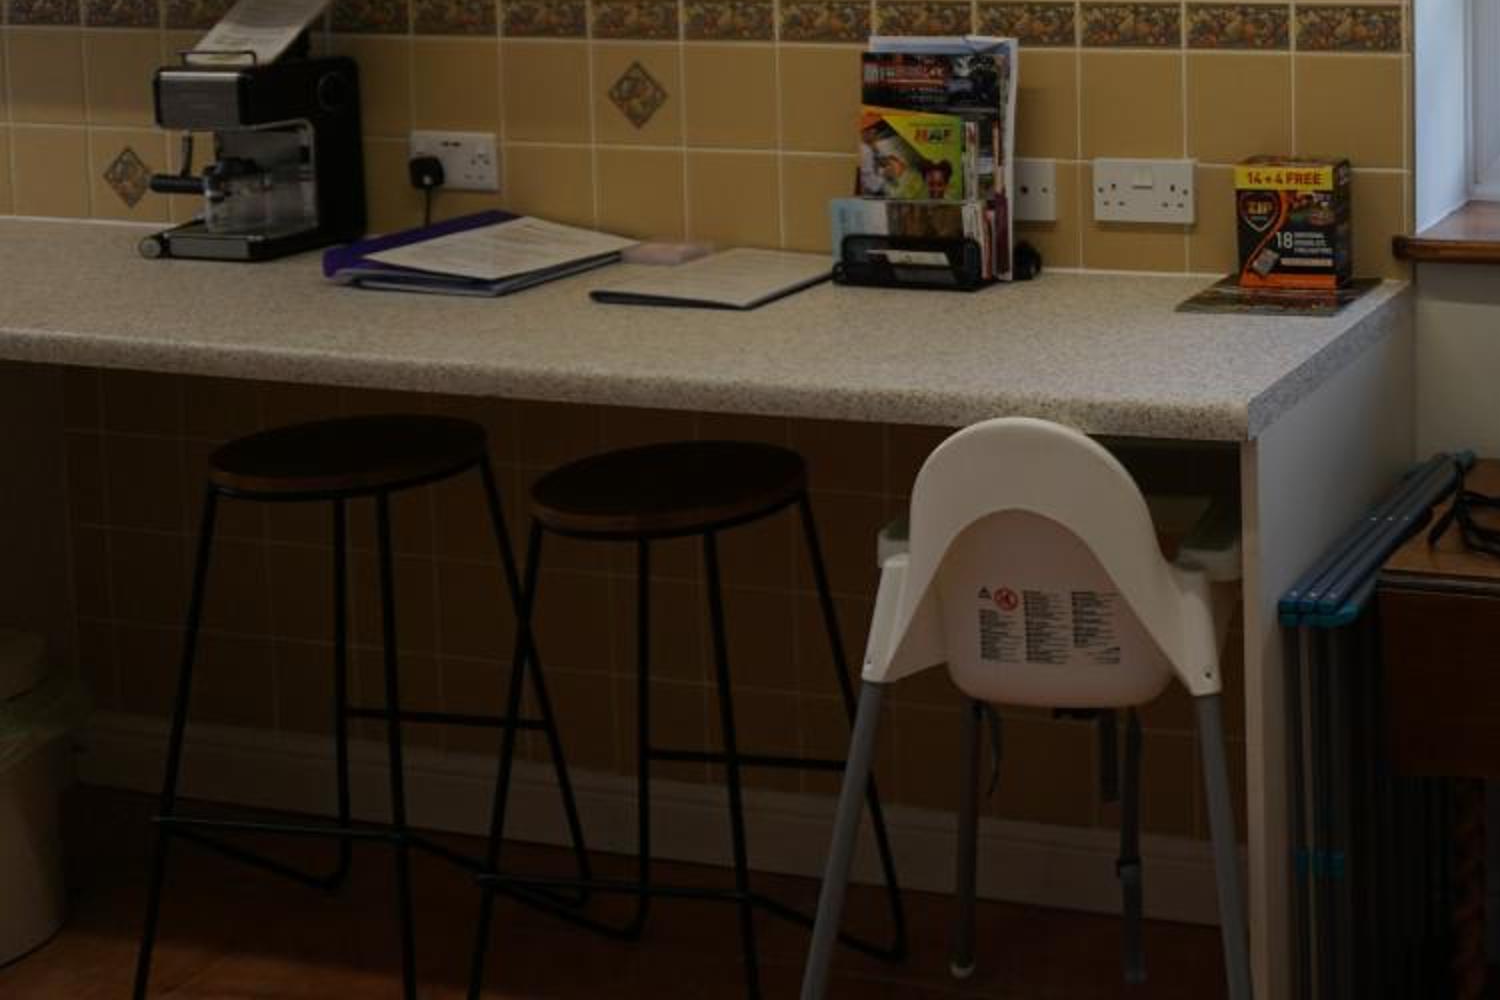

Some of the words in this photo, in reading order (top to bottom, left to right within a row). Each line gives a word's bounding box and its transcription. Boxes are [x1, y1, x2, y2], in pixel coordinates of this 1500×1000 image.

[1247, 171, 1262, 184] 14
[1274, 173, 1283, 184] 4
[1286, 172, 1323, 185] FREE
[1275, 231, 1294, 249] 18
